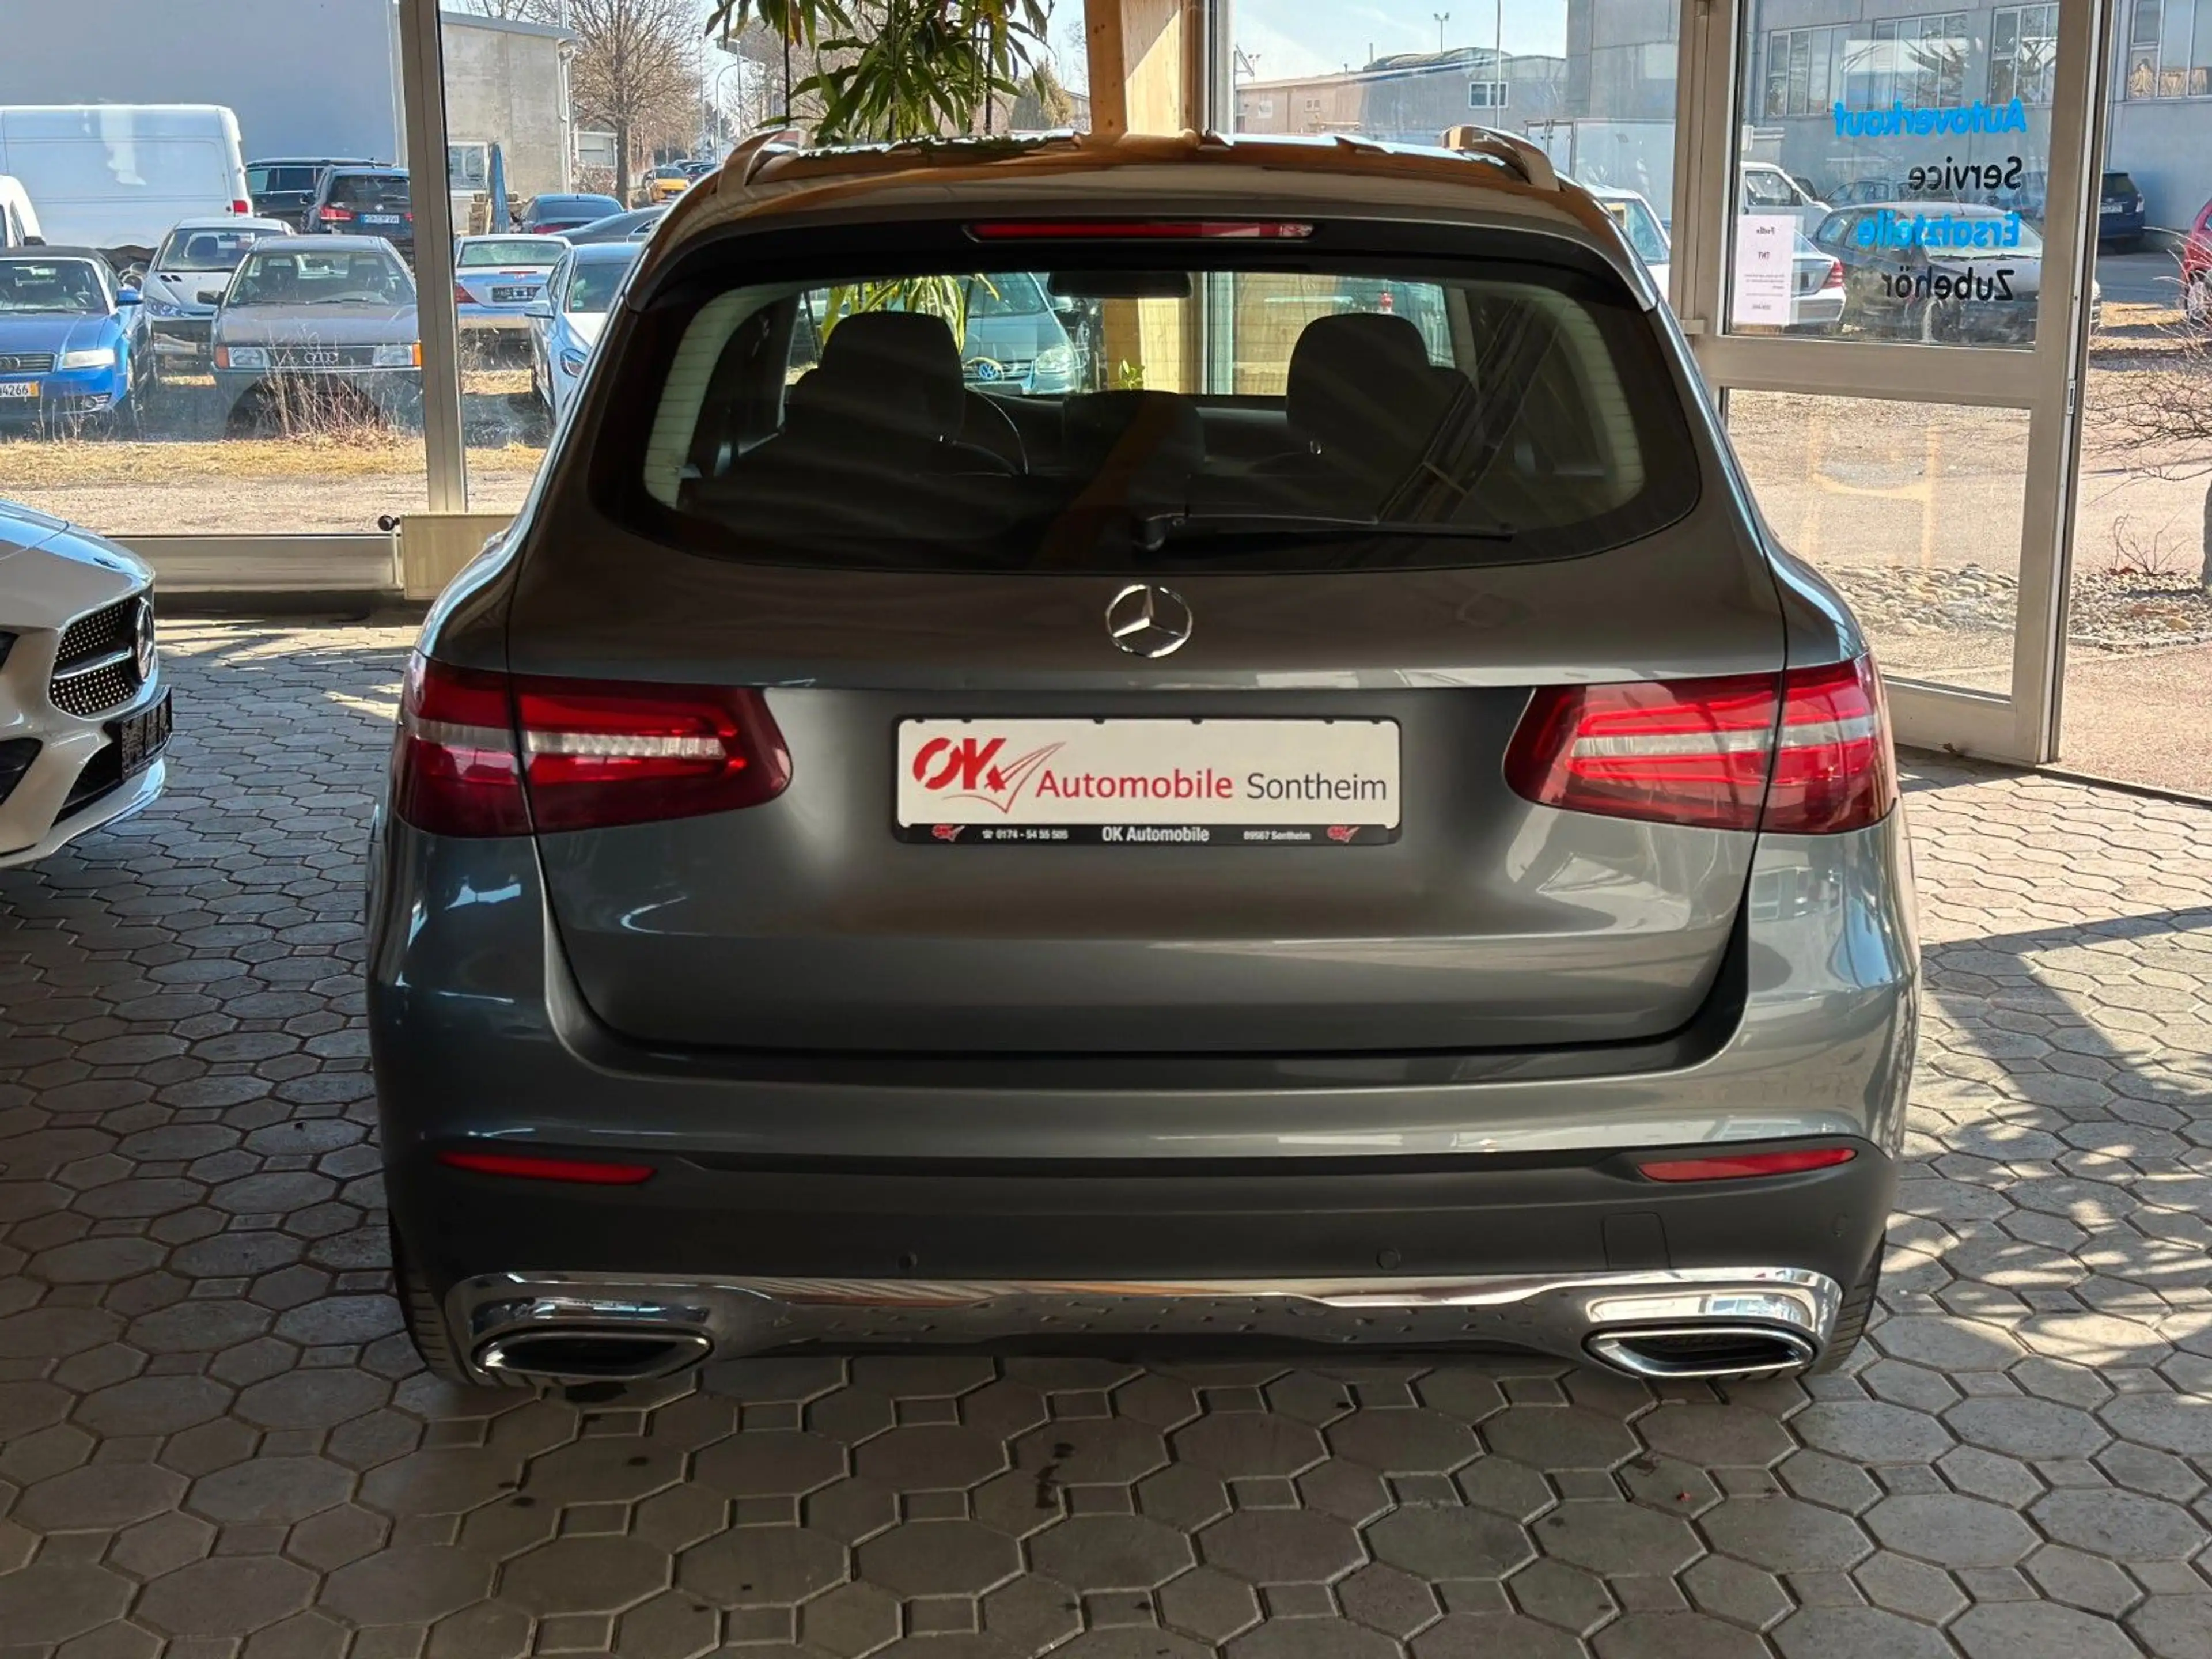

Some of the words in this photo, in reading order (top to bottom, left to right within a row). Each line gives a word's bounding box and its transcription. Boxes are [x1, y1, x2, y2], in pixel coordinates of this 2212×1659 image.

[0, 384, 28, 395] 4266
[912, 737, 1007, 791] OK
[1036, 768, 1233, 799] Automobile
[1246, 772, 1387, 801] Sontheim
[1102, 826, 1123, 842] OK
[1126, 826, 1210, 842] Automobile
